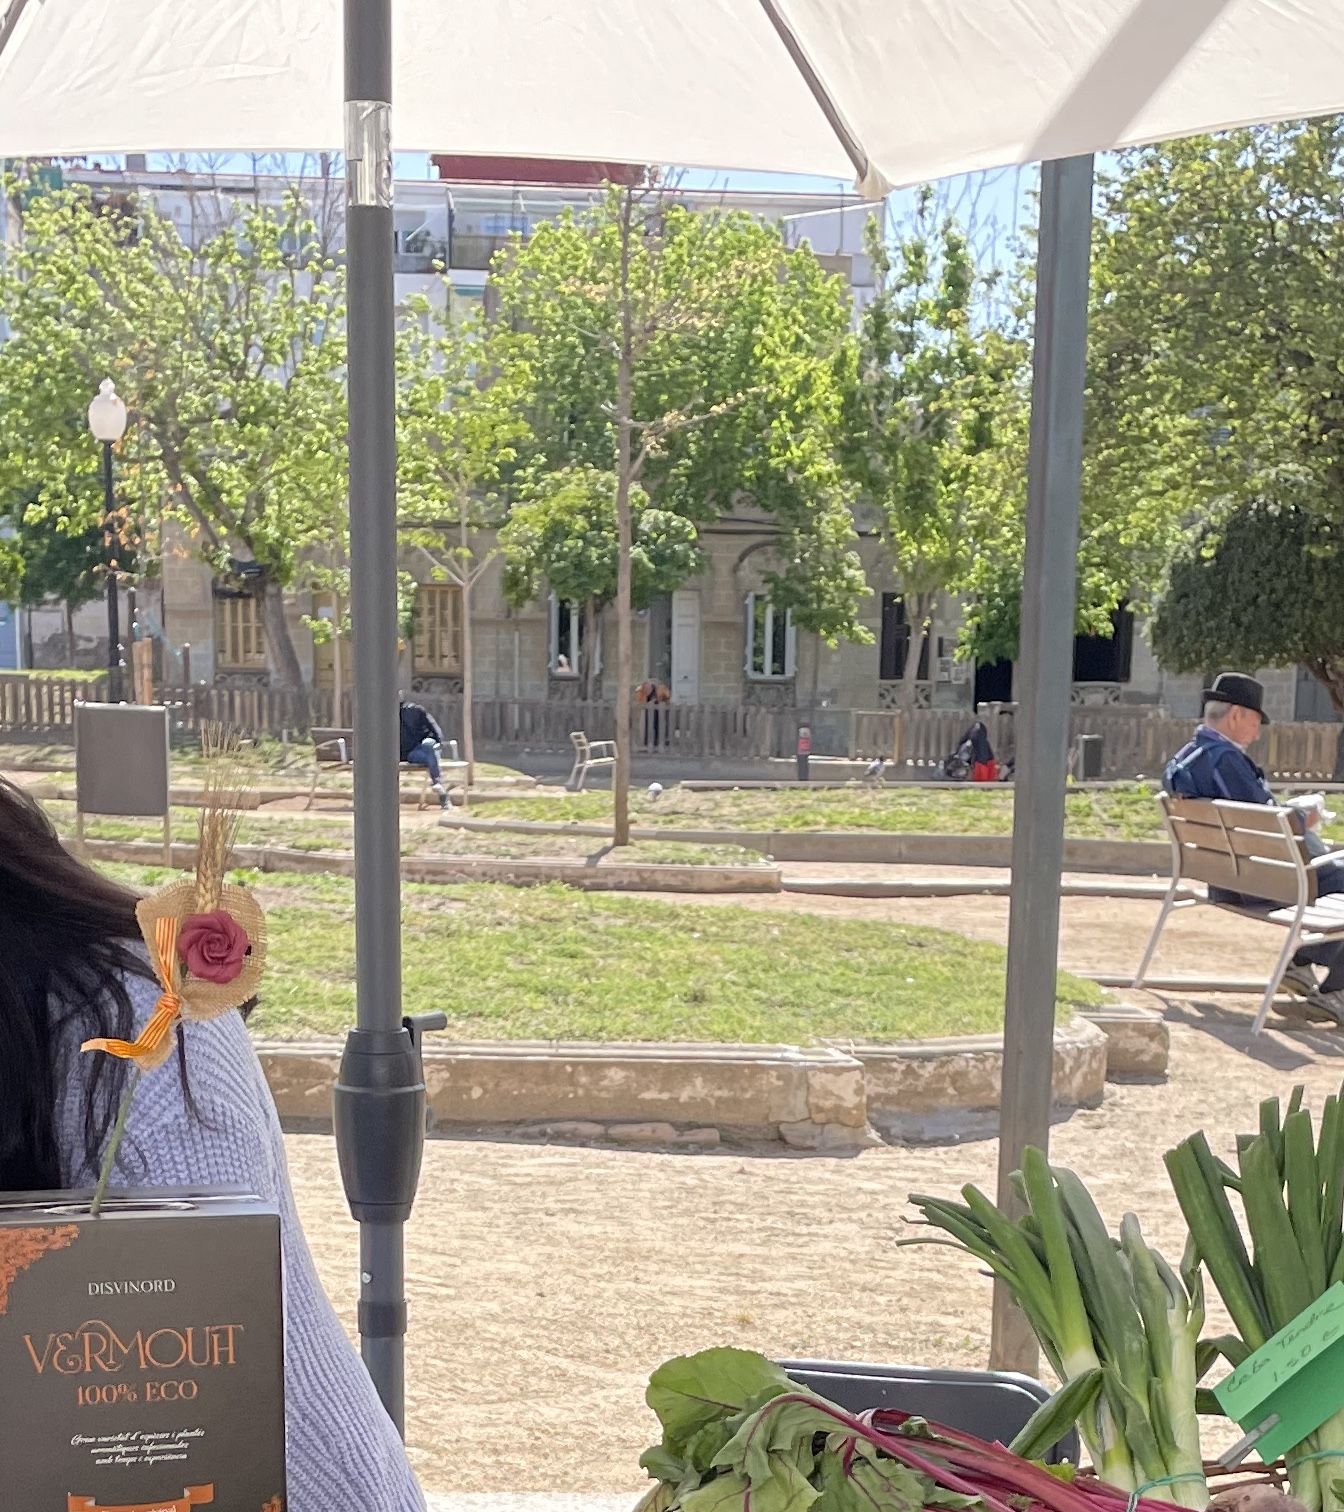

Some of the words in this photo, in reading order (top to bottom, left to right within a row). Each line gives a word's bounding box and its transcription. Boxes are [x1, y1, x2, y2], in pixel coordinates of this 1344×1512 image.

[87, 1278, 176, 1297] DISVINORD
[78, 1383, 138, 1407] 100%
[146, 1379, 199, 1402] ECO
